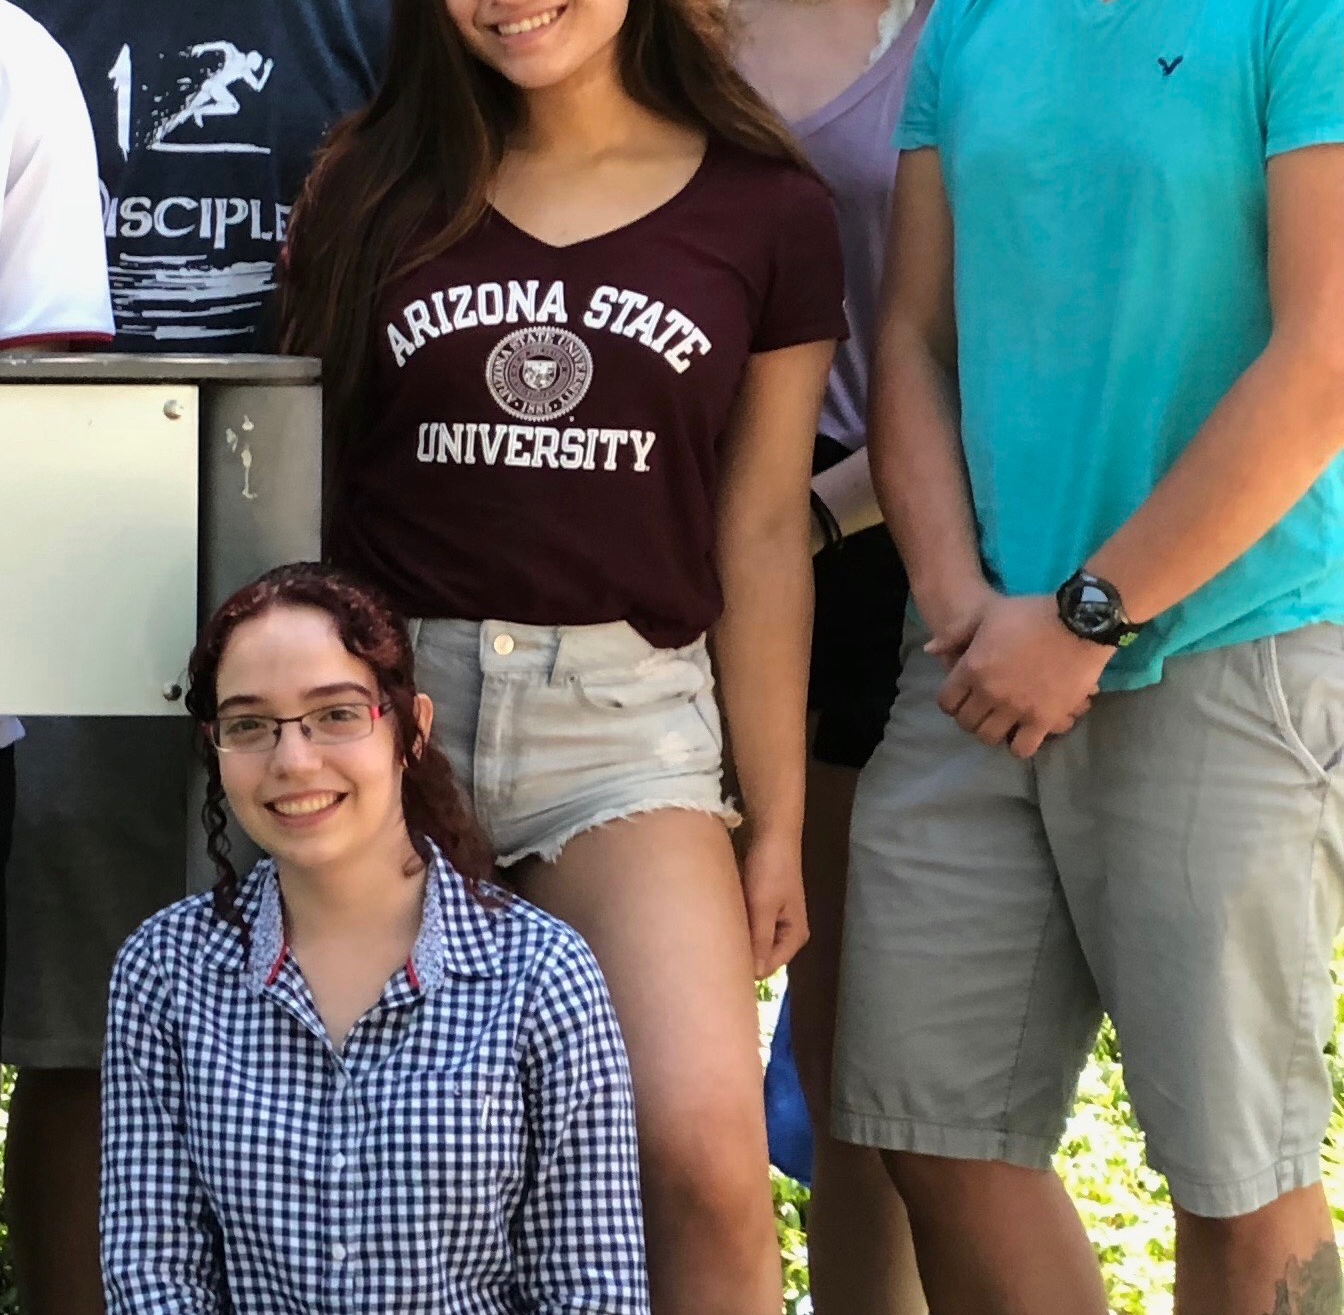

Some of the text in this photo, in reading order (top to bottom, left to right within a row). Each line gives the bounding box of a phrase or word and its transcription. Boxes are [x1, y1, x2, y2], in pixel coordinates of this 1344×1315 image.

[386, 279, 568, 368] ARIZONA
[583, 285, 712, 374] STATE
[416, 422, 656, 472] UNIVERSITY
